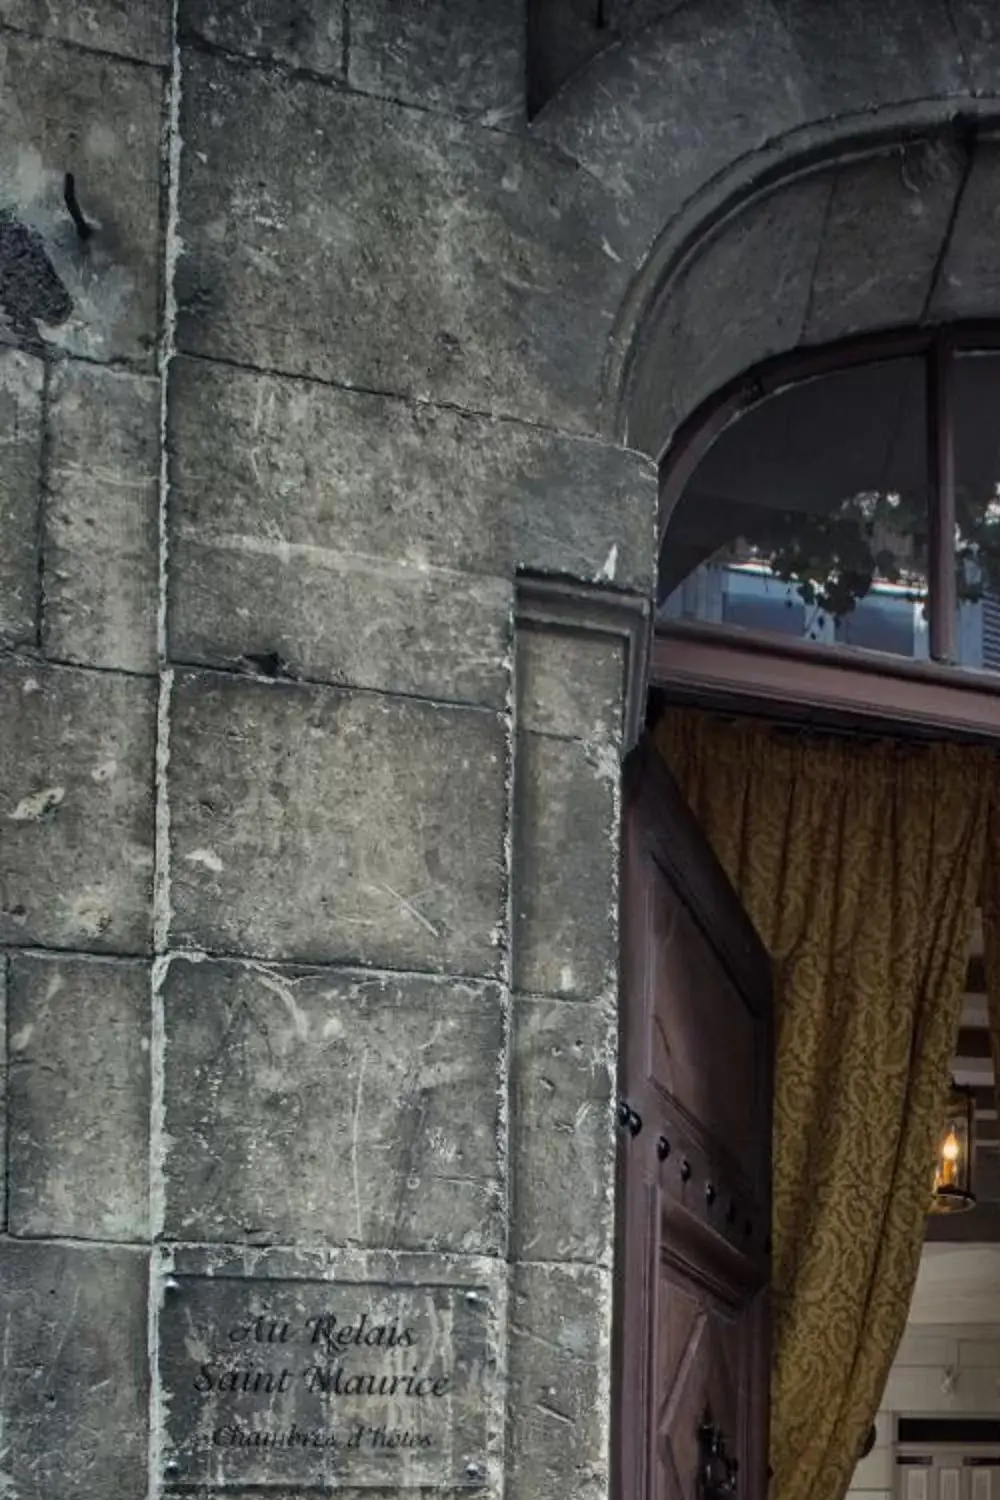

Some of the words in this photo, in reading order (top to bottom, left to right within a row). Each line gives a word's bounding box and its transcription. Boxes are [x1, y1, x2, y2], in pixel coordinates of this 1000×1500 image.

[228, 1314, 290, 1344] Au
[305, 1312, 418, 1353] Relais
[193, 1360, 294, 1394] Saint
[303, 1365, 450, 1398] Maurice
